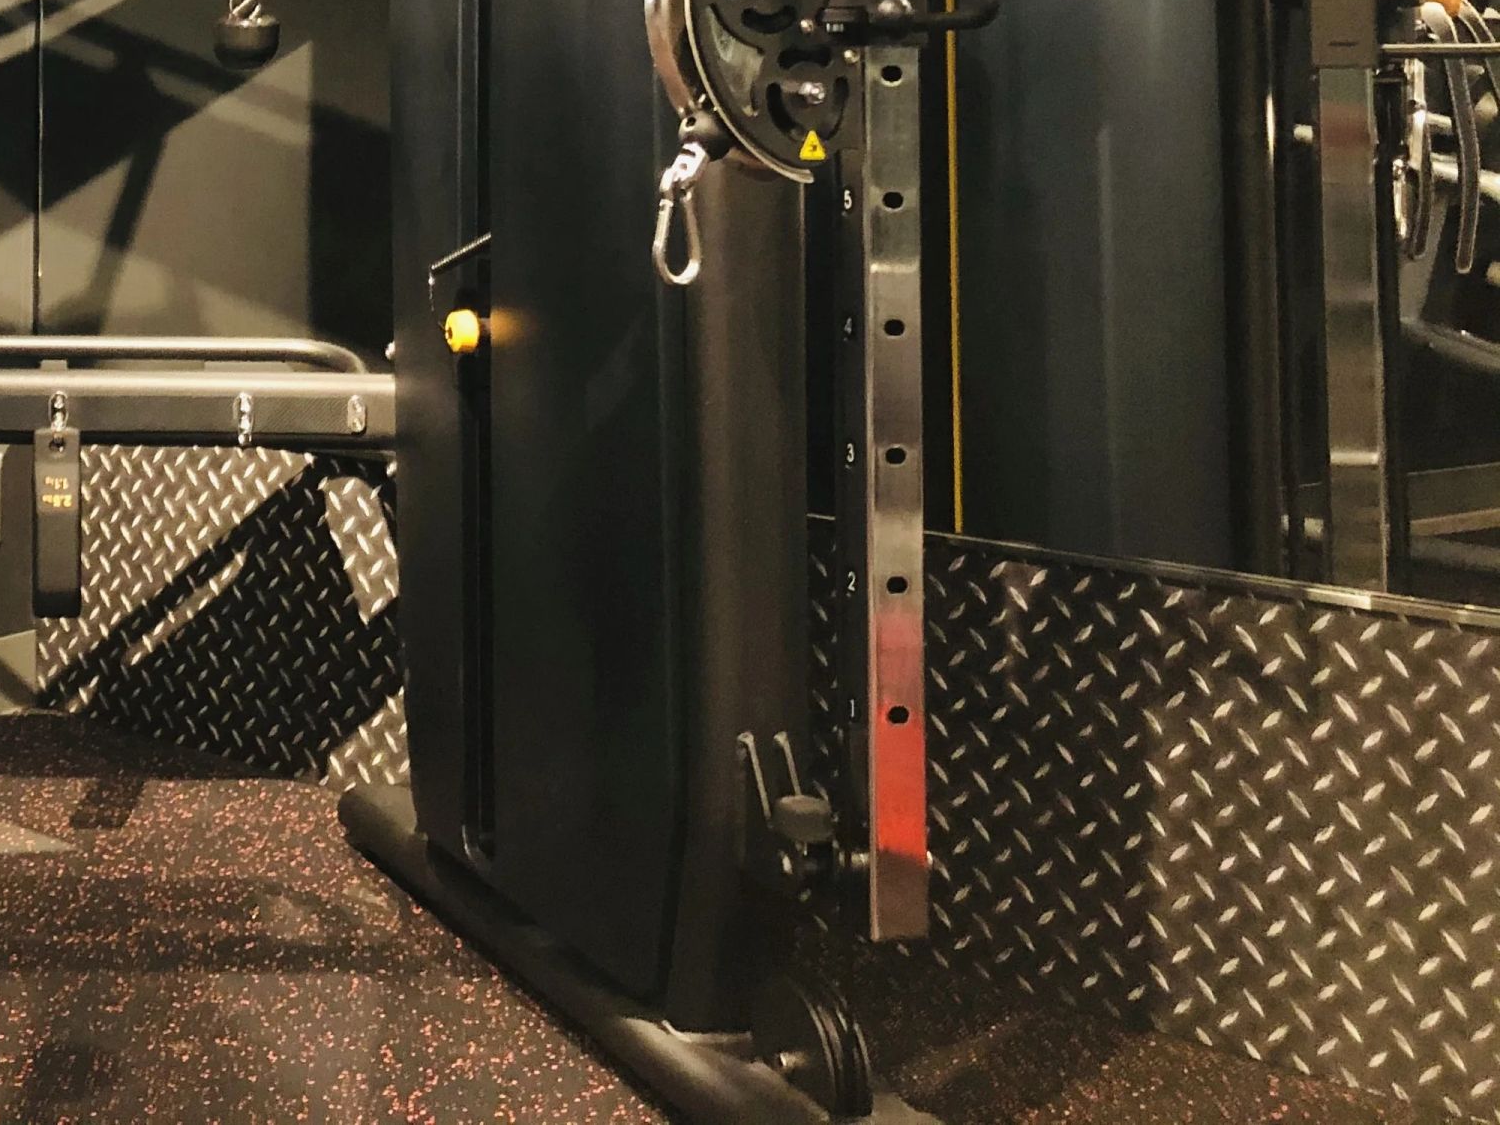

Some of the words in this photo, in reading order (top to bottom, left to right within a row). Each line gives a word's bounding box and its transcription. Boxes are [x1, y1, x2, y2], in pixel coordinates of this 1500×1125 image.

[843, 189, 852, 210] 5
[846, 442, 855, 463] 3
[847, 570, 856, 592] 2
[849, 698, 855, 718] 1
